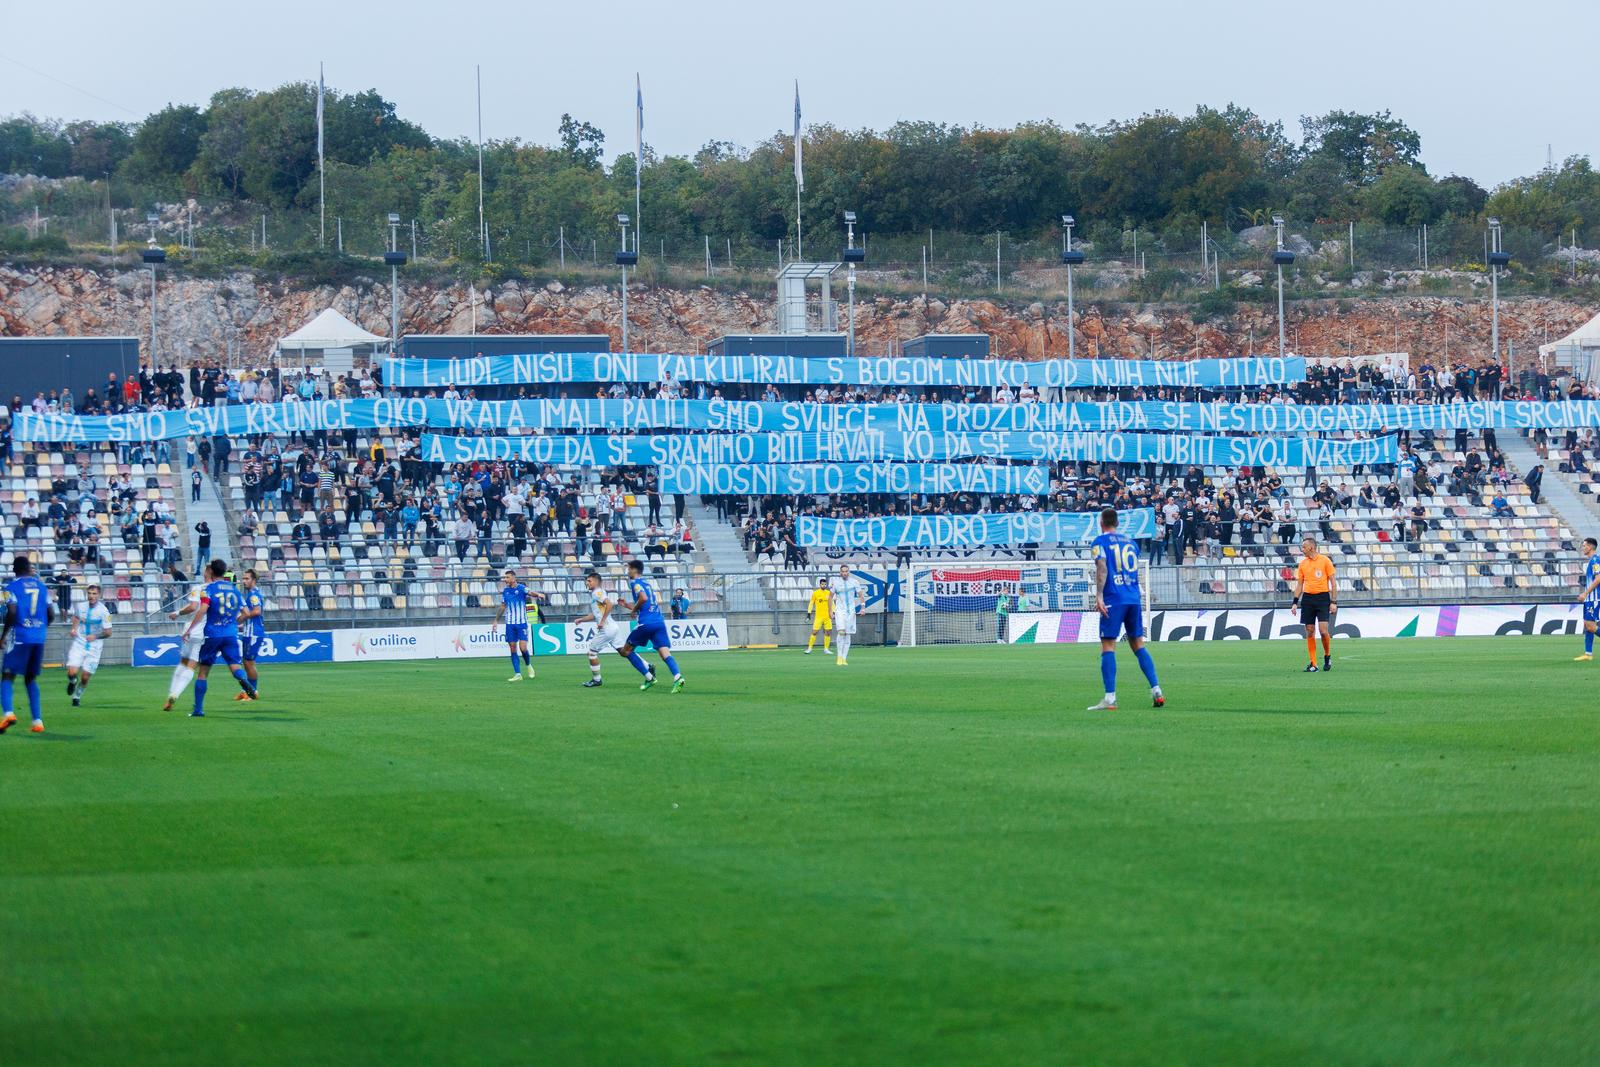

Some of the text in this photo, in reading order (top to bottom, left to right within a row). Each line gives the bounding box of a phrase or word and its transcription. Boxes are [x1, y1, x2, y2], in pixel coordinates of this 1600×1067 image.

[385, 357, 405, 386] TI
[513, 353, 572, 384] NISU
[594, 353, 637, 381] ONI
[657, 356, 809, 383] KALKULIRALI
[827, 358, 844, 384] S
[1045, 359, 1078, 387] OD
[1092, 359, 1143, 387] NJIH
[1155, 359, 1202, 387] NIJE
[21, 414, 87, 442] TADA
[106, 411, 166, 442] SMO
[185, 406, 230, 436] SVI
[246, 398, 354, 434] KRUNICE
[374, 398, 427, 428] OKO
[446, 399, 526, 429] VRATA
[707, 401, 763, 432] SMO
[897, 403, 931, 432] NA
[1096, 401, 1148, 431] TADA
[1162, 402, 1192, 430] SE
[430, 437, 446, 462] A
[454, 436, 511, 462] SAD
[521, 436, 553, 462] KO
[564, 436, 597, 465] DA
[607, 436, 637, 465] SE
[650, 433, 754, 465] SRAMIMO
[768, 431, 803, 463] BITI
[903, 431, 934, 461] KO
[944, 431, 973, 460] DA
[979, 431, 1012, 459] SE
[1028, 431, 1125, 462] SRAMIMO
[1136, 432, 1214, 465] LJUBITI
[1230, 436, 1288, 466] SVOJ
[1302, 435, 1390, 467] NAROD!
[658, 463, 777, 495] PONOSNI
[855, 463, 910, 494] SMO
[799, 509, 1152, 547] BLAGO ZADRO 1991-222
[1109, 543, 1138, 574] 16
[25, 588, 39, 616] 7
[370, 634, 416, 646] uniline
[470, 631, 507, 643] unilin
[672, 624, 719, 639] SAVA
